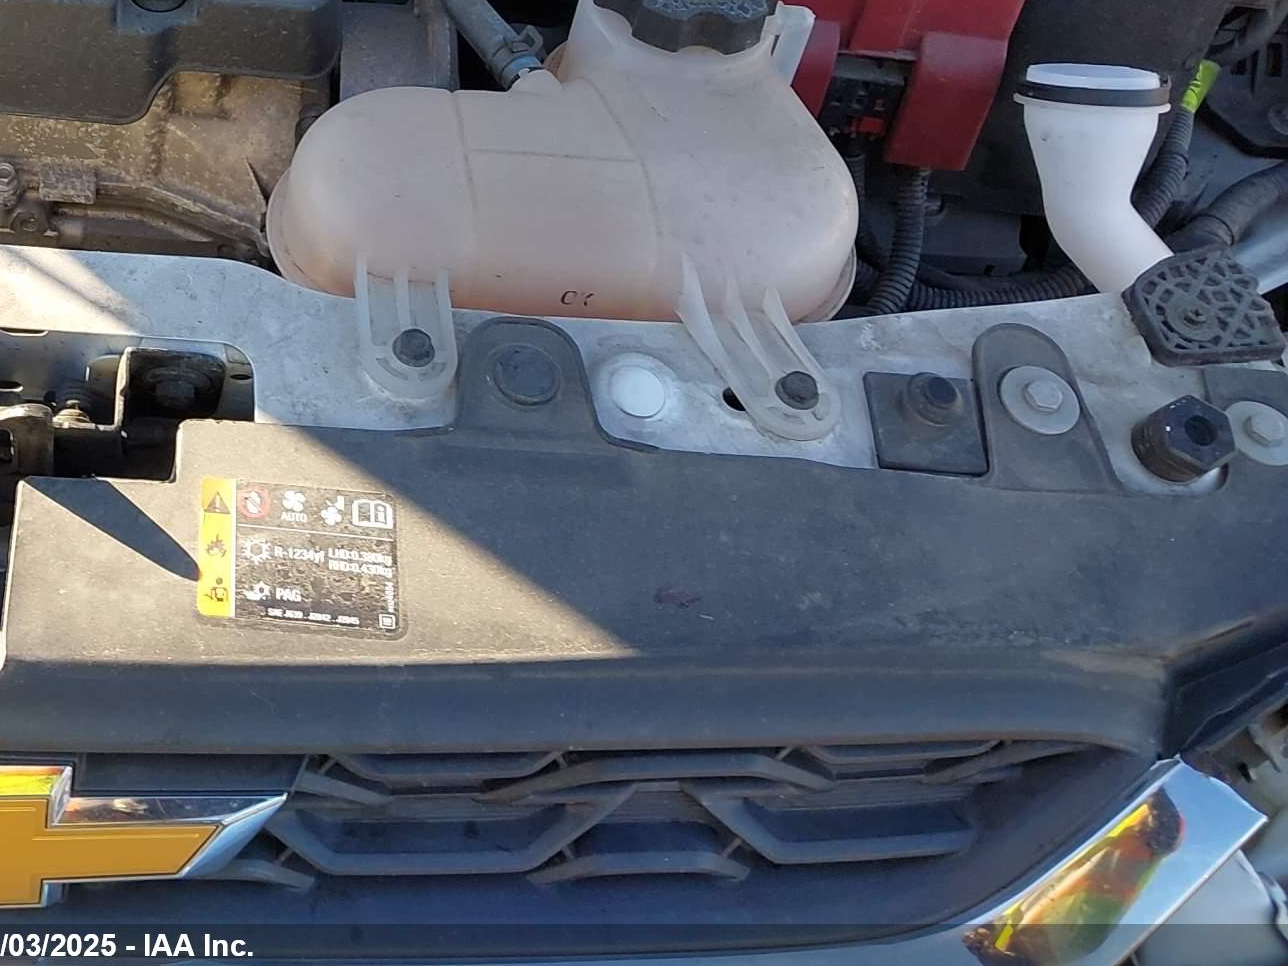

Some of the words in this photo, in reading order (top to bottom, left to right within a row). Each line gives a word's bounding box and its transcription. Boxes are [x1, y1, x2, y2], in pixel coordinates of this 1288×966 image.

[280, 511, 308, 523] AUTO
[273, 545, 325, 564] R-1234yf
[275, 587, 302, 602] PAG
